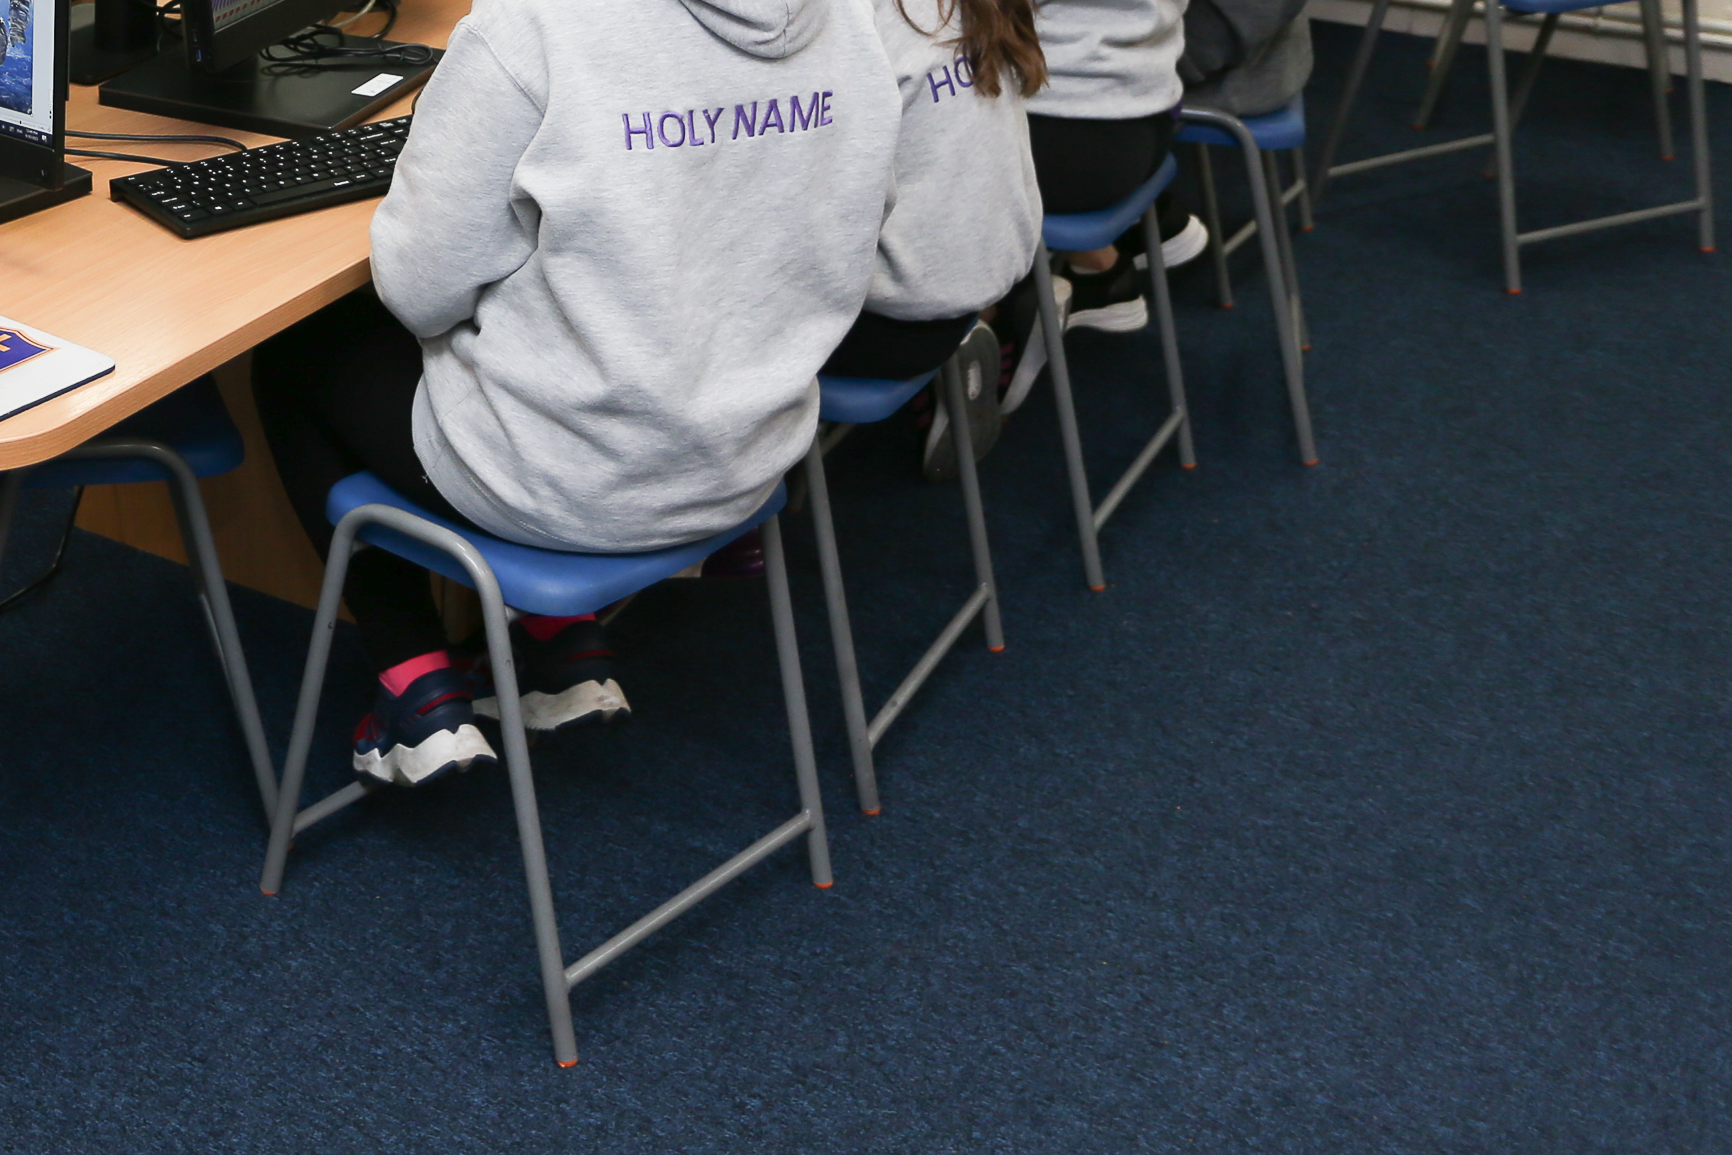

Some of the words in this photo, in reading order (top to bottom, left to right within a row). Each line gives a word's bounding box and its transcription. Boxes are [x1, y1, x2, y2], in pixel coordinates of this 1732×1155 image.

[927, 56, 974, 103] HO
[621, 106, 725, 150] HOLY
[731, 89, 834, 140] NAME
